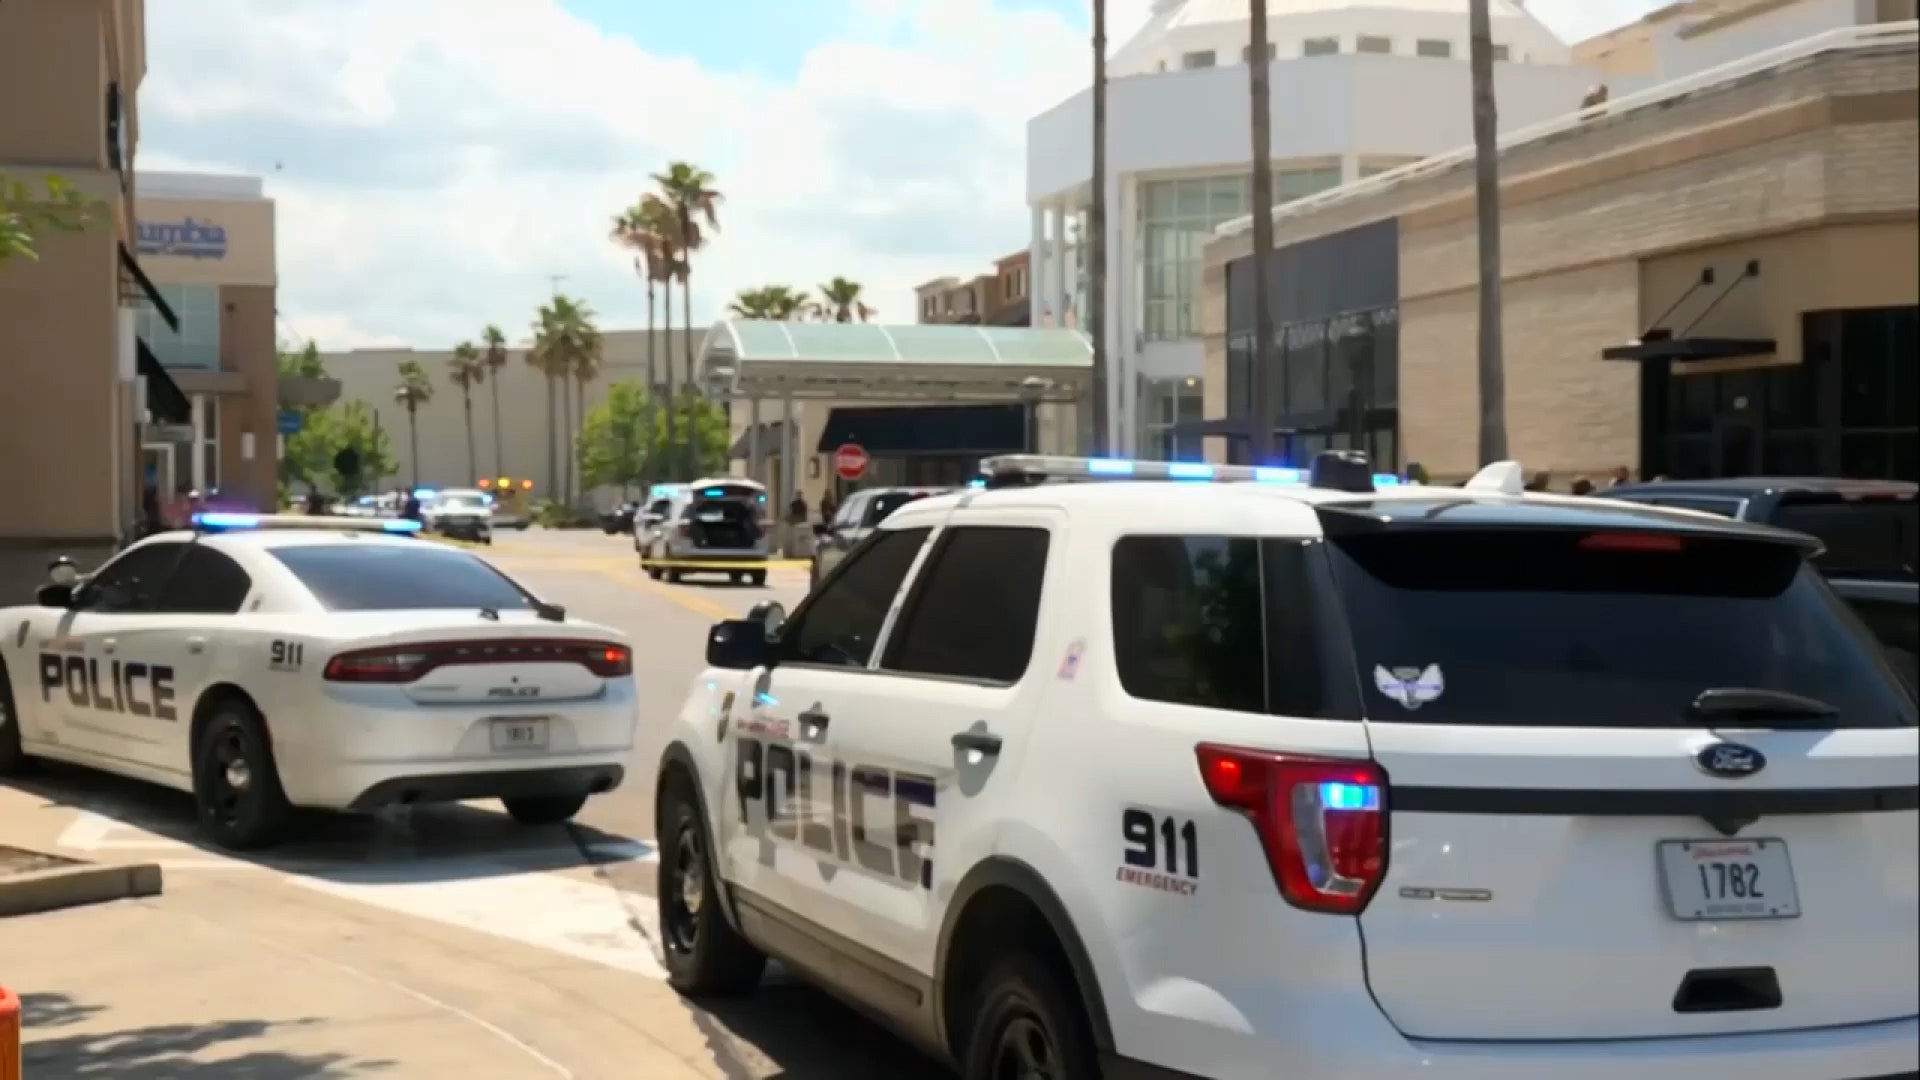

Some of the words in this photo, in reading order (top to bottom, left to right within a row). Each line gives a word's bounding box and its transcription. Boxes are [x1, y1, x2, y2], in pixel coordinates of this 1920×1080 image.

[270, 639, 303, 665] 911
[39, 652, 178, 722] POLICE
[736, 736, 936, 890] POLICE
[1122, 808, 1199, 878] 911
[1116, 866, 1198, 897] EMERGENCY
[1698, 863, 1764, 899] 1782
